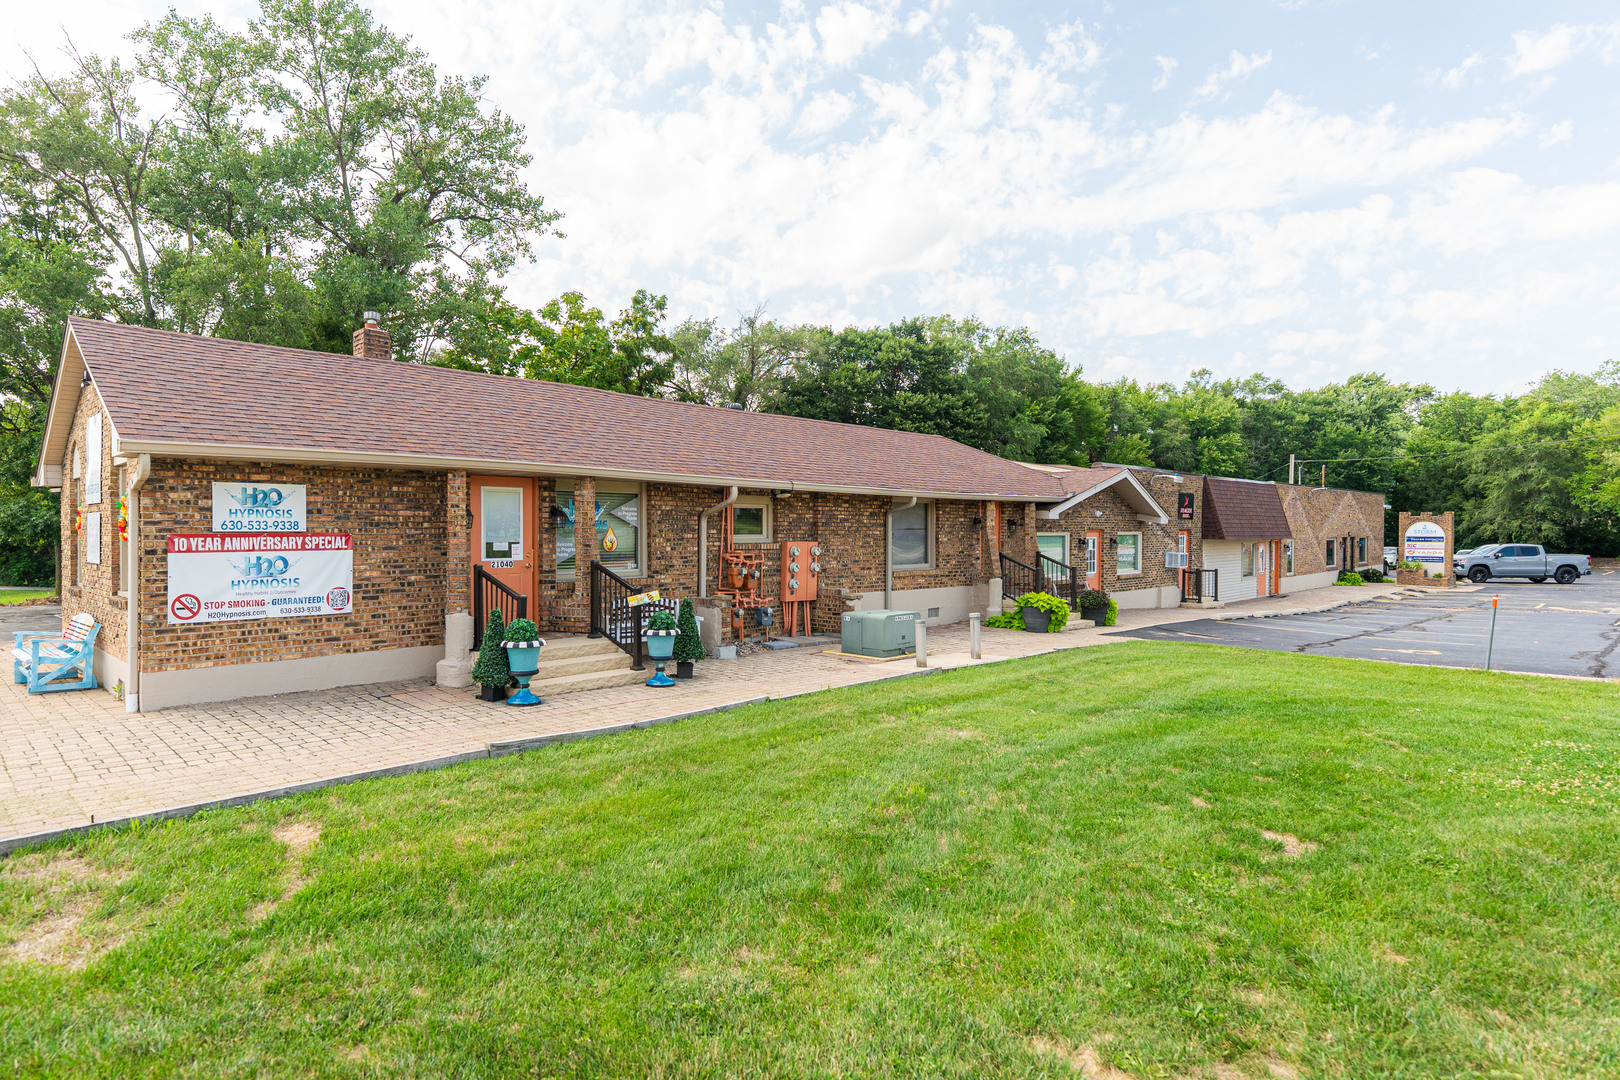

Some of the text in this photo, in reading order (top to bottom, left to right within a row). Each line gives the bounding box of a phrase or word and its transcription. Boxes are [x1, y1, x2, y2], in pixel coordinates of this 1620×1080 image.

[241, 487, 282, 507] H2O
[228, 508, 293, 518] HYPNOSIS
[220, 520, 300, 530] 630-533-9338
[174, 536, 348, 552] 10 YEAR ANNIVERSARY SPECIAL
[244, 555, 289, 577] H2O
[231, 578, 300, 590] HYPNOSIS
[204, 600, 225, 610] STOP
[227, 599, 266, 608] SMOKING
[272, 596, 325, 606] GUARANTEED!
[280, 606, 321, 615] 630-533-9338
